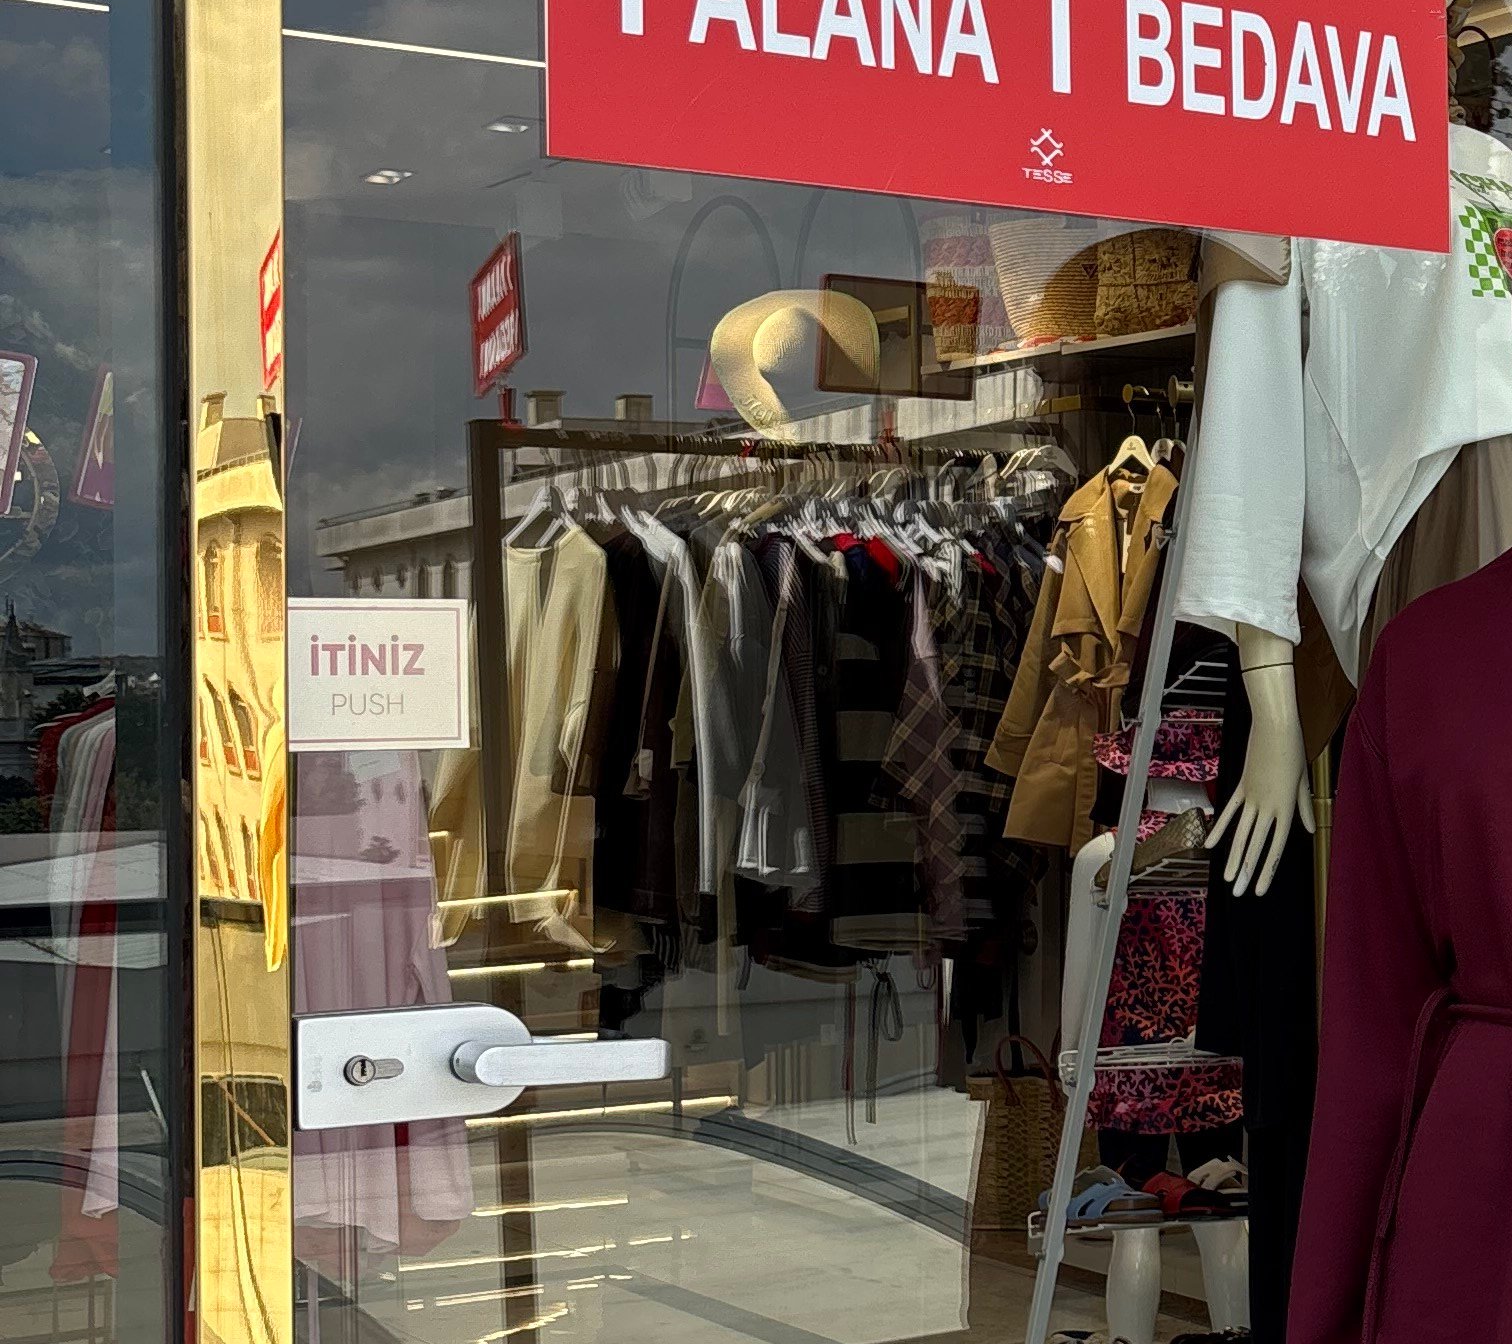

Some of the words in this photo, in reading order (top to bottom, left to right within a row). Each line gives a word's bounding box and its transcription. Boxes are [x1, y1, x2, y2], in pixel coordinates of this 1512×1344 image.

[1021, 167, 1074, 184] TESSE
[310, 634, 426, 677] İTİNİZ
[331, 692, 405, 716] PUSH
